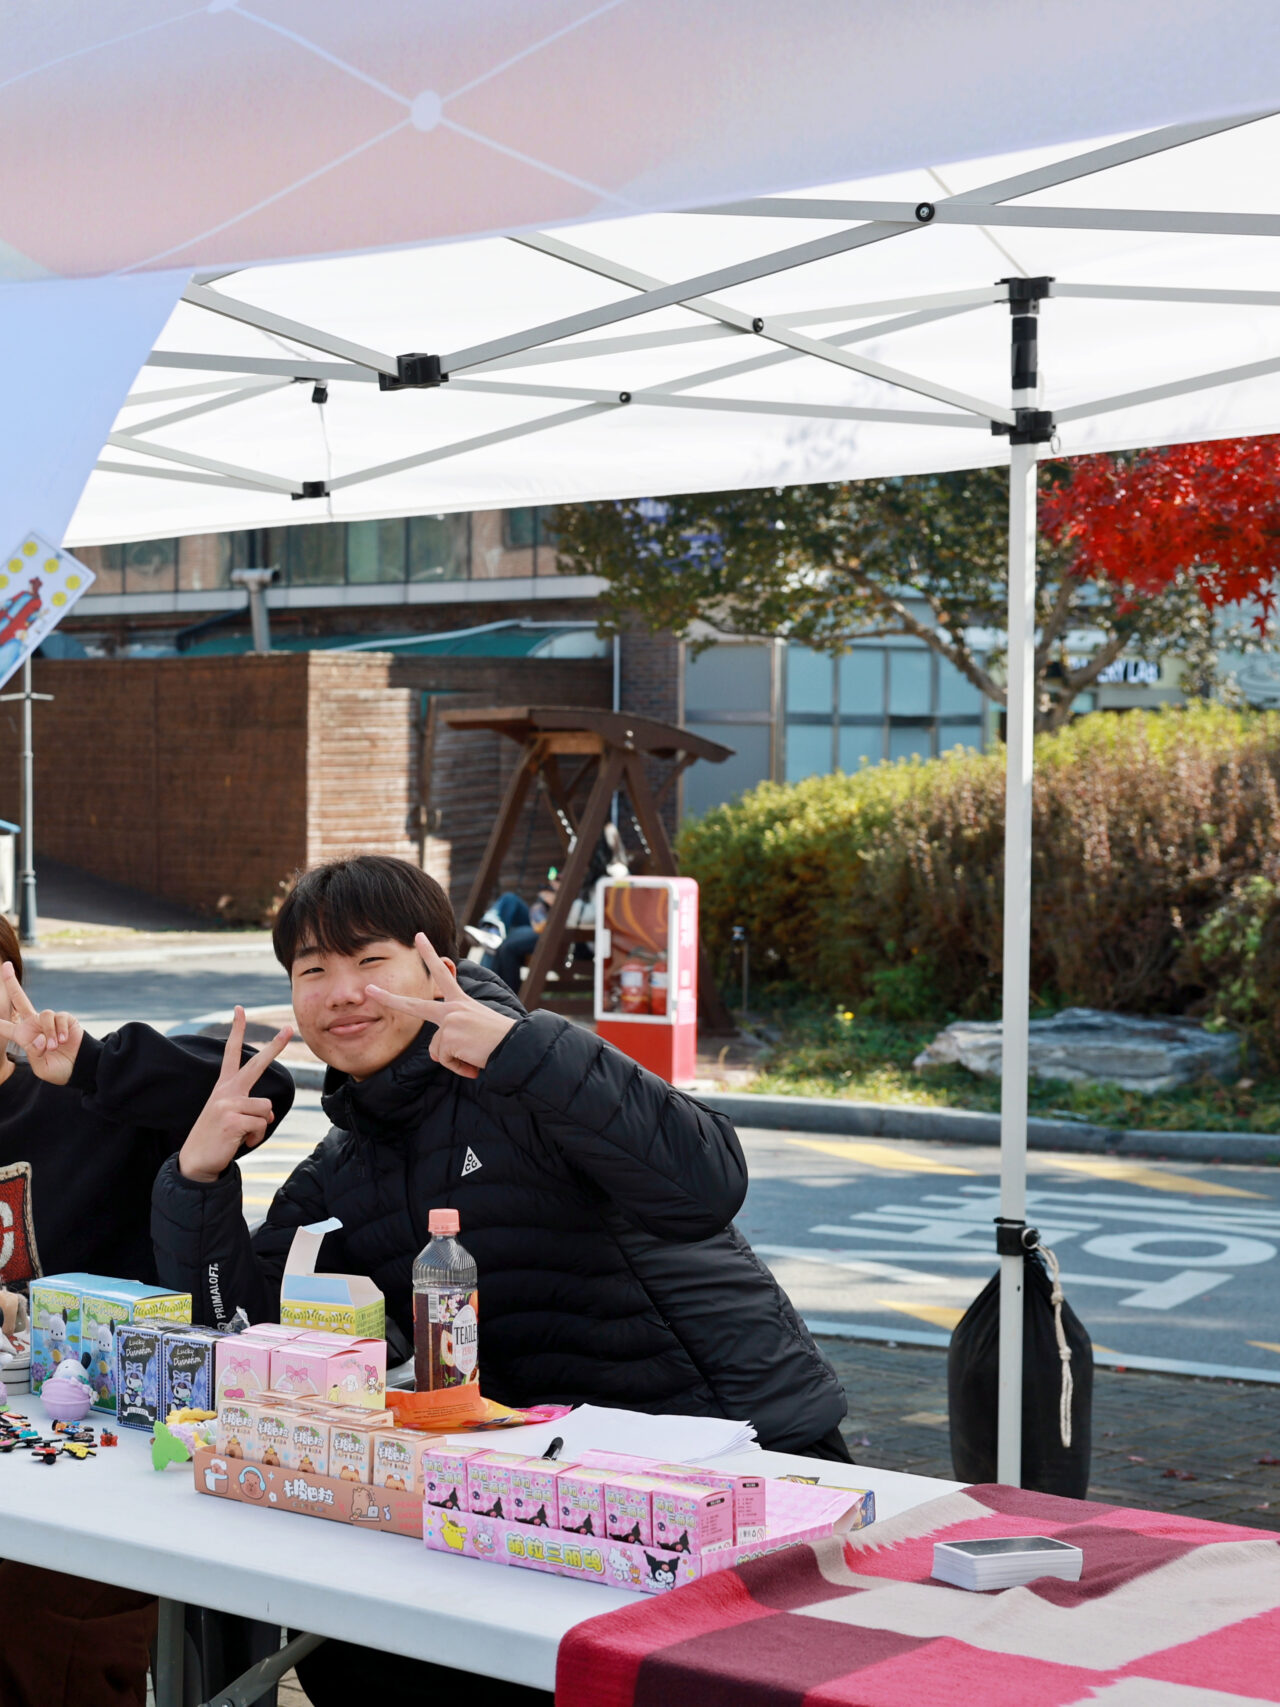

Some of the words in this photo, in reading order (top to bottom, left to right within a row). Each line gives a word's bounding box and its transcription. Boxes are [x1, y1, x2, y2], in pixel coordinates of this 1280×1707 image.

[129, 1339, 146, 1348] Lucky
[454, 1324, 477, 1345] TEAZLE
[176, 1348, 195, 1357] Lucky
[283, 1478, 335, 1505] 卡皮巴拉
[506, 1531, 605, 1575] 萌粒三丽鸥
